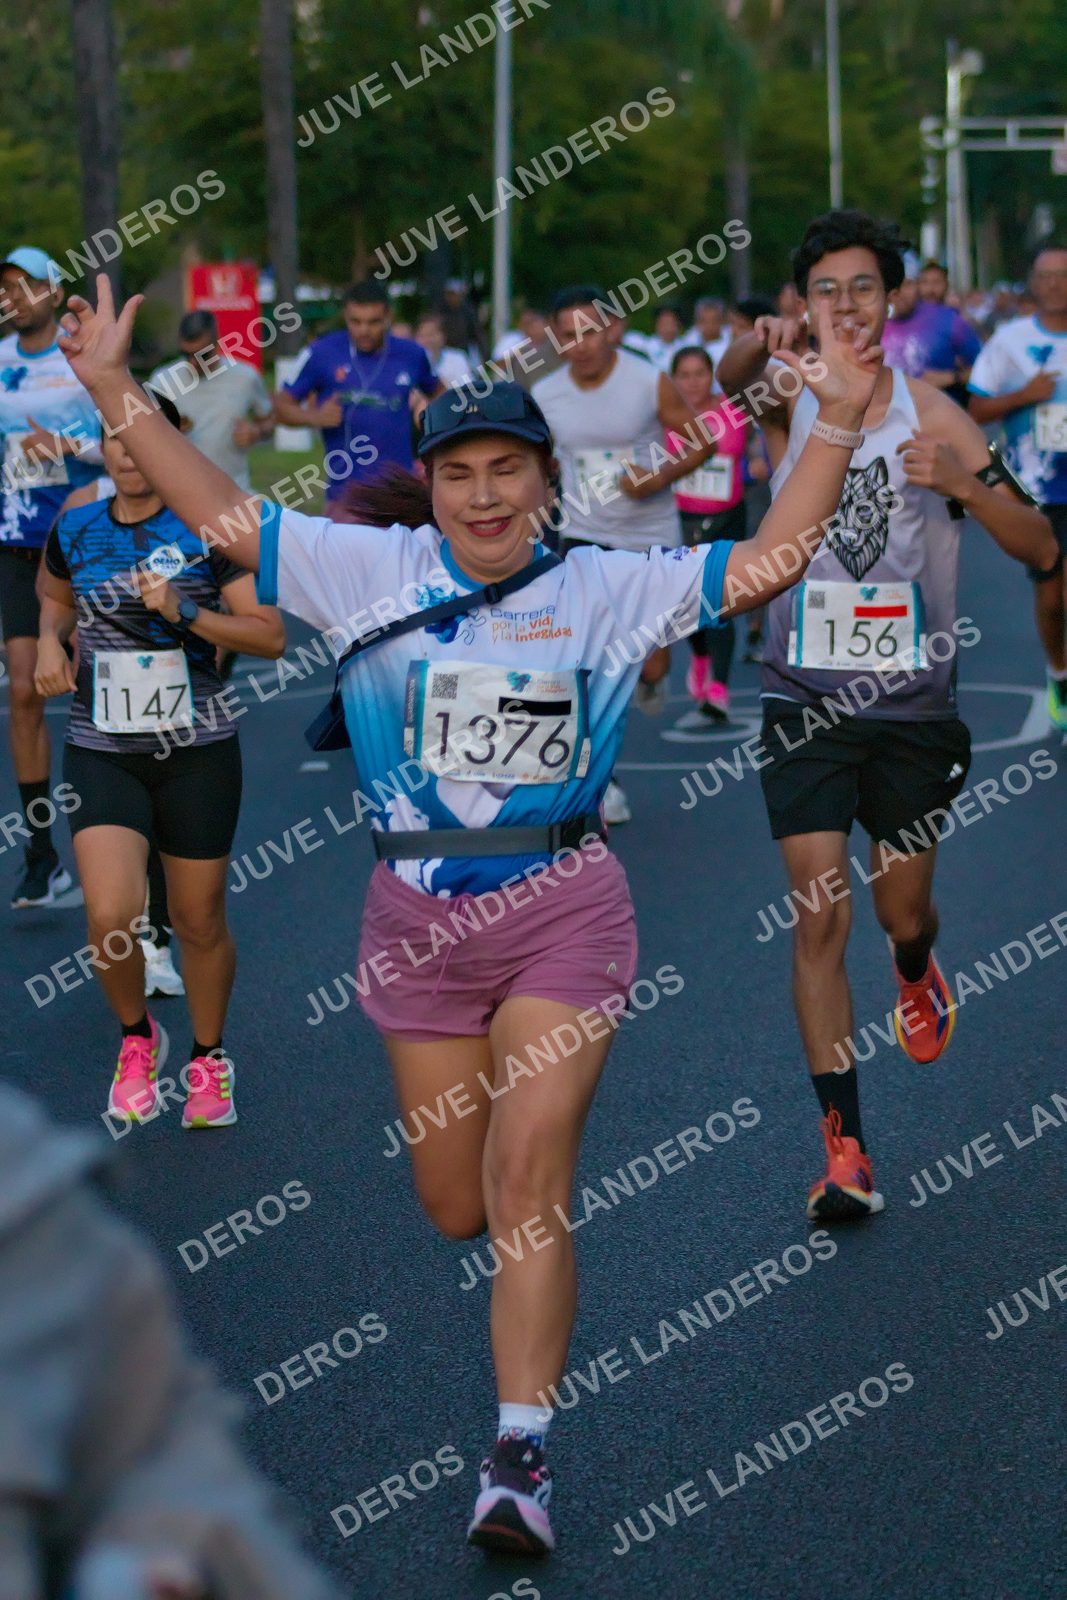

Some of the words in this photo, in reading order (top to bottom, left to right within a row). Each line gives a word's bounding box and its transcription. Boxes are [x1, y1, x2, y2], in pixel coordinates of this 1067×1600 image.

[490, 605, 555, 621] Carrera
[824, 619, 897, 657] 156
[101, 684, 187, 721] 1147
[436, 712, 570, 768] 1376
